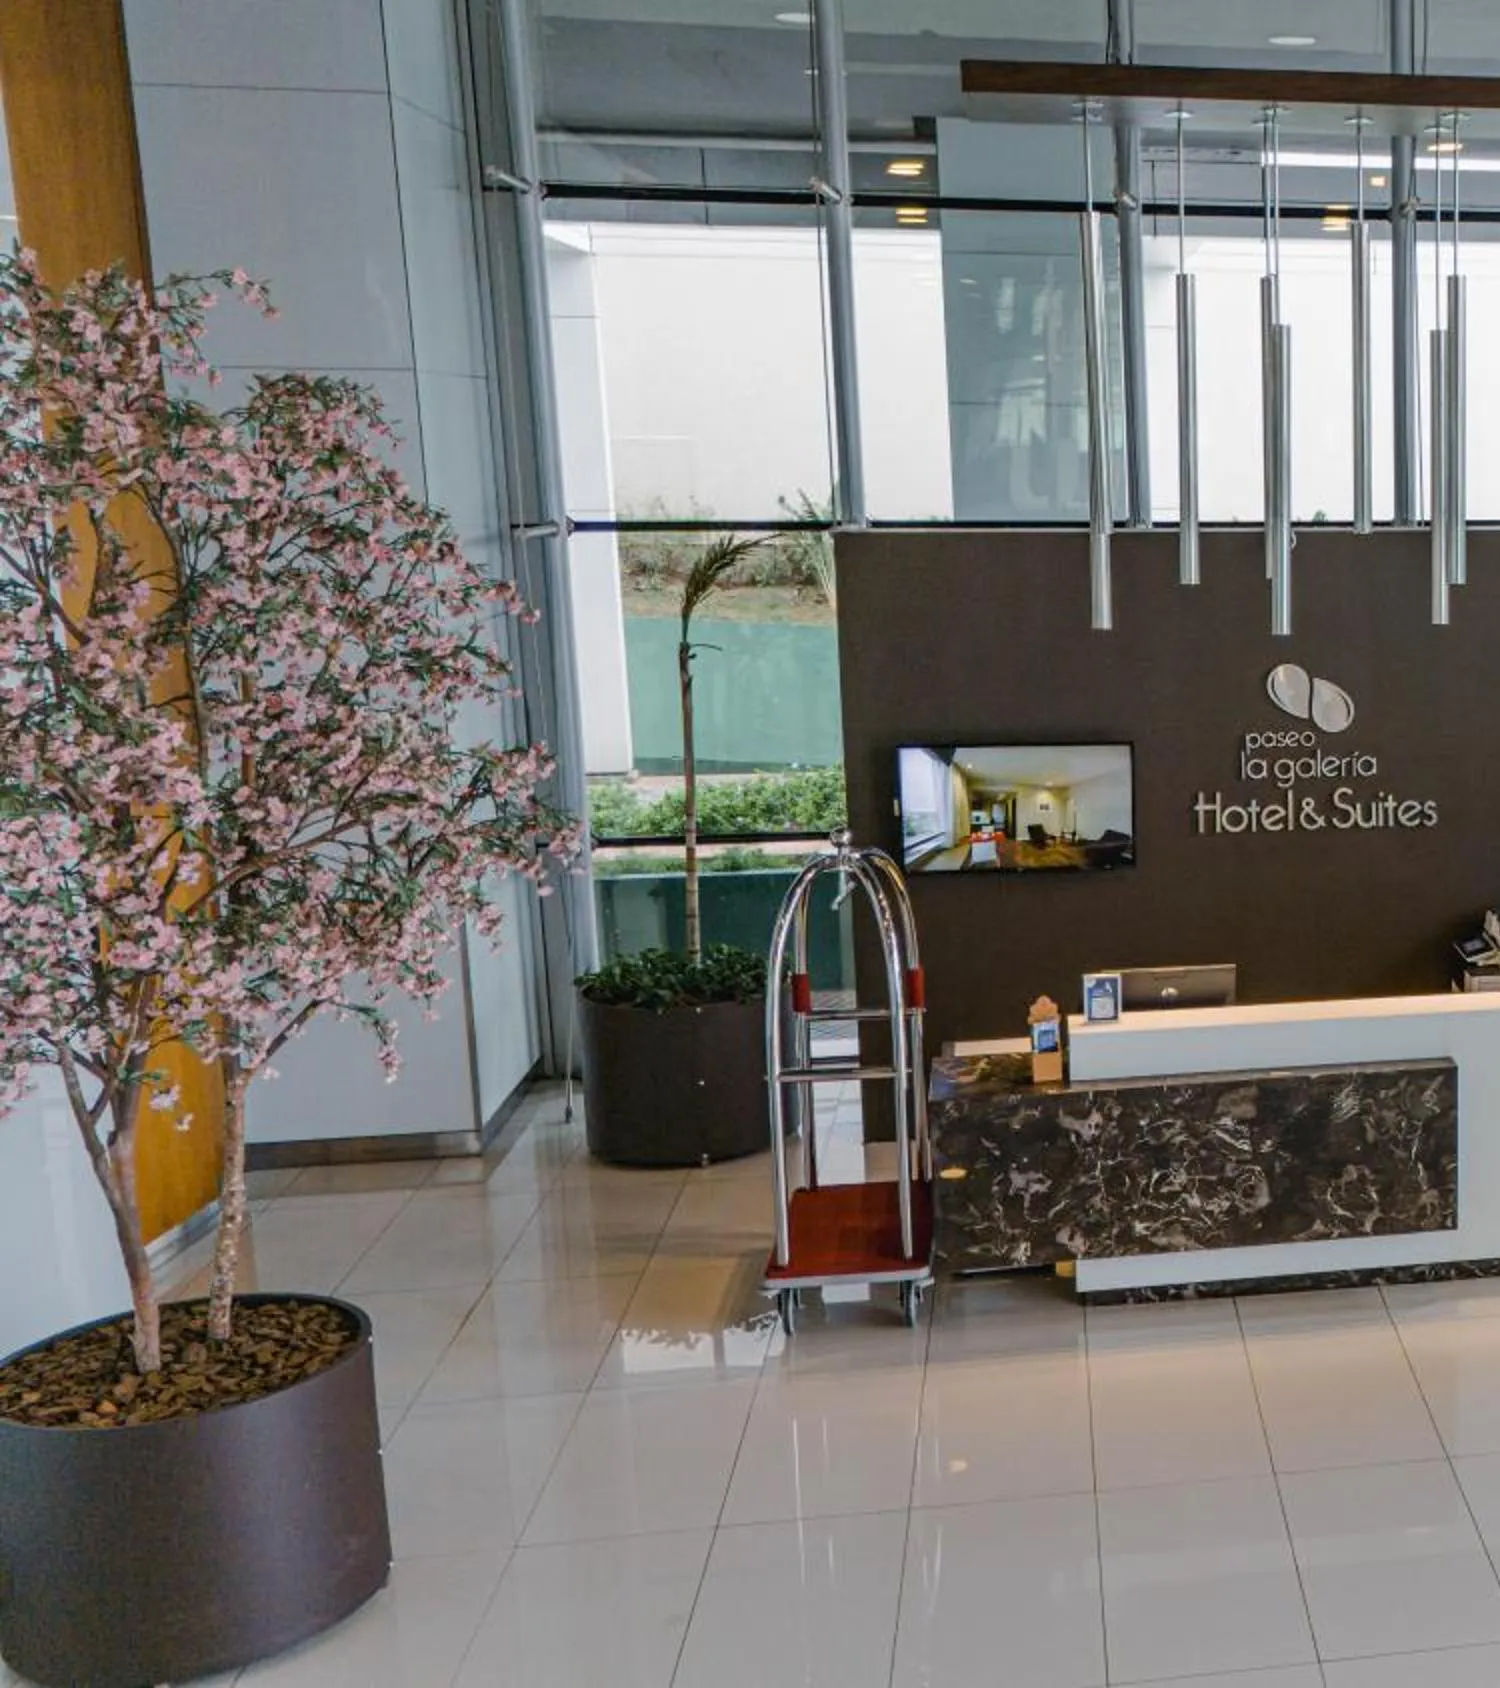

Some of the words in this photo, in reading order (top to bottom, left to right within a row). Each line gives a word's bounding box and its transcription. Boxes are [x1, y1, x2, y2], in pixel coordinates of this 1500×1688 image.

[1245, 730, 1315, 754] paseo
[1240, 750, 1267, 780] la
[1273, 748, 1377, 788] galería
[1194, 789, 1294, 834] Hotel
[1300, 796, 1326, 830] &
[1332, 787, 1439, 830] Suites
